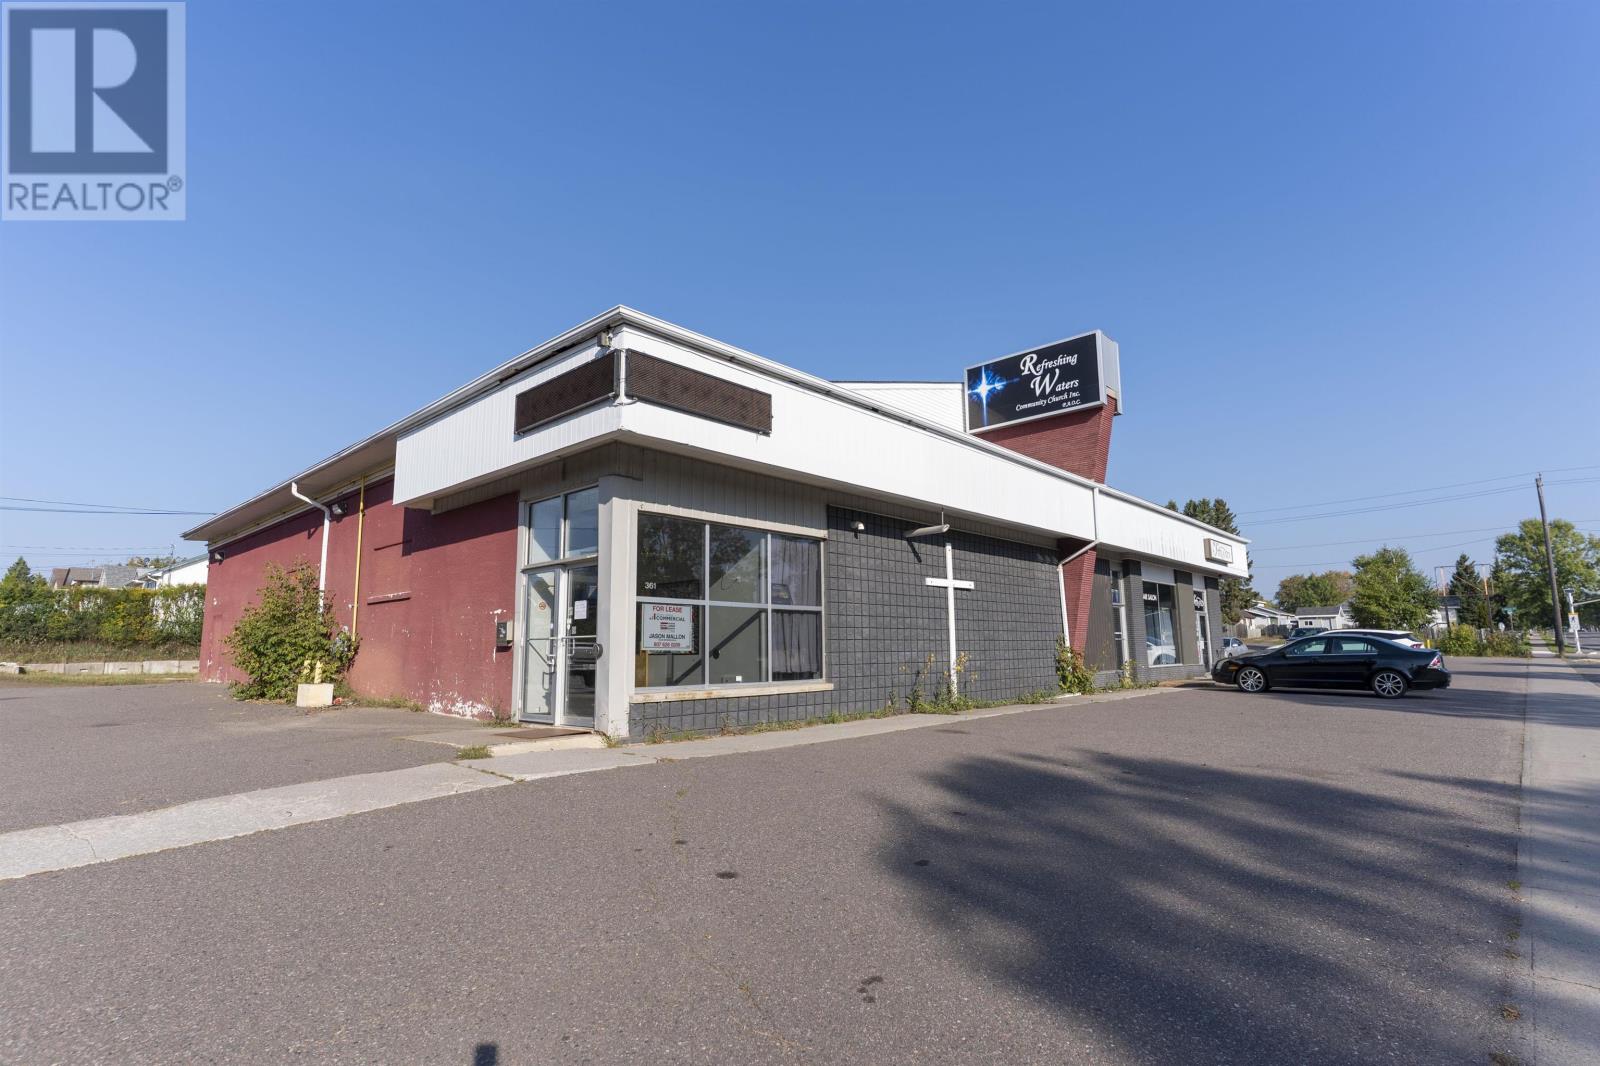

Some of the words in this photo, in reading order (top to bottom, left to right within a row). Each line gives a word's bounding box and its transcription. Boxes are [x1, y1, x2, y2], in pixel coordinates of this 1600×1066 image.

[1020, 353, 1078, 376] Refreshing
[1030, 368, 1079, 397] Waters
[1015, 399, 1047, 412] Community
[1047, 391, 1068, 404] Church
[644, 582, 657, 590] 361
[665, 606, 683, 614] LEASE
